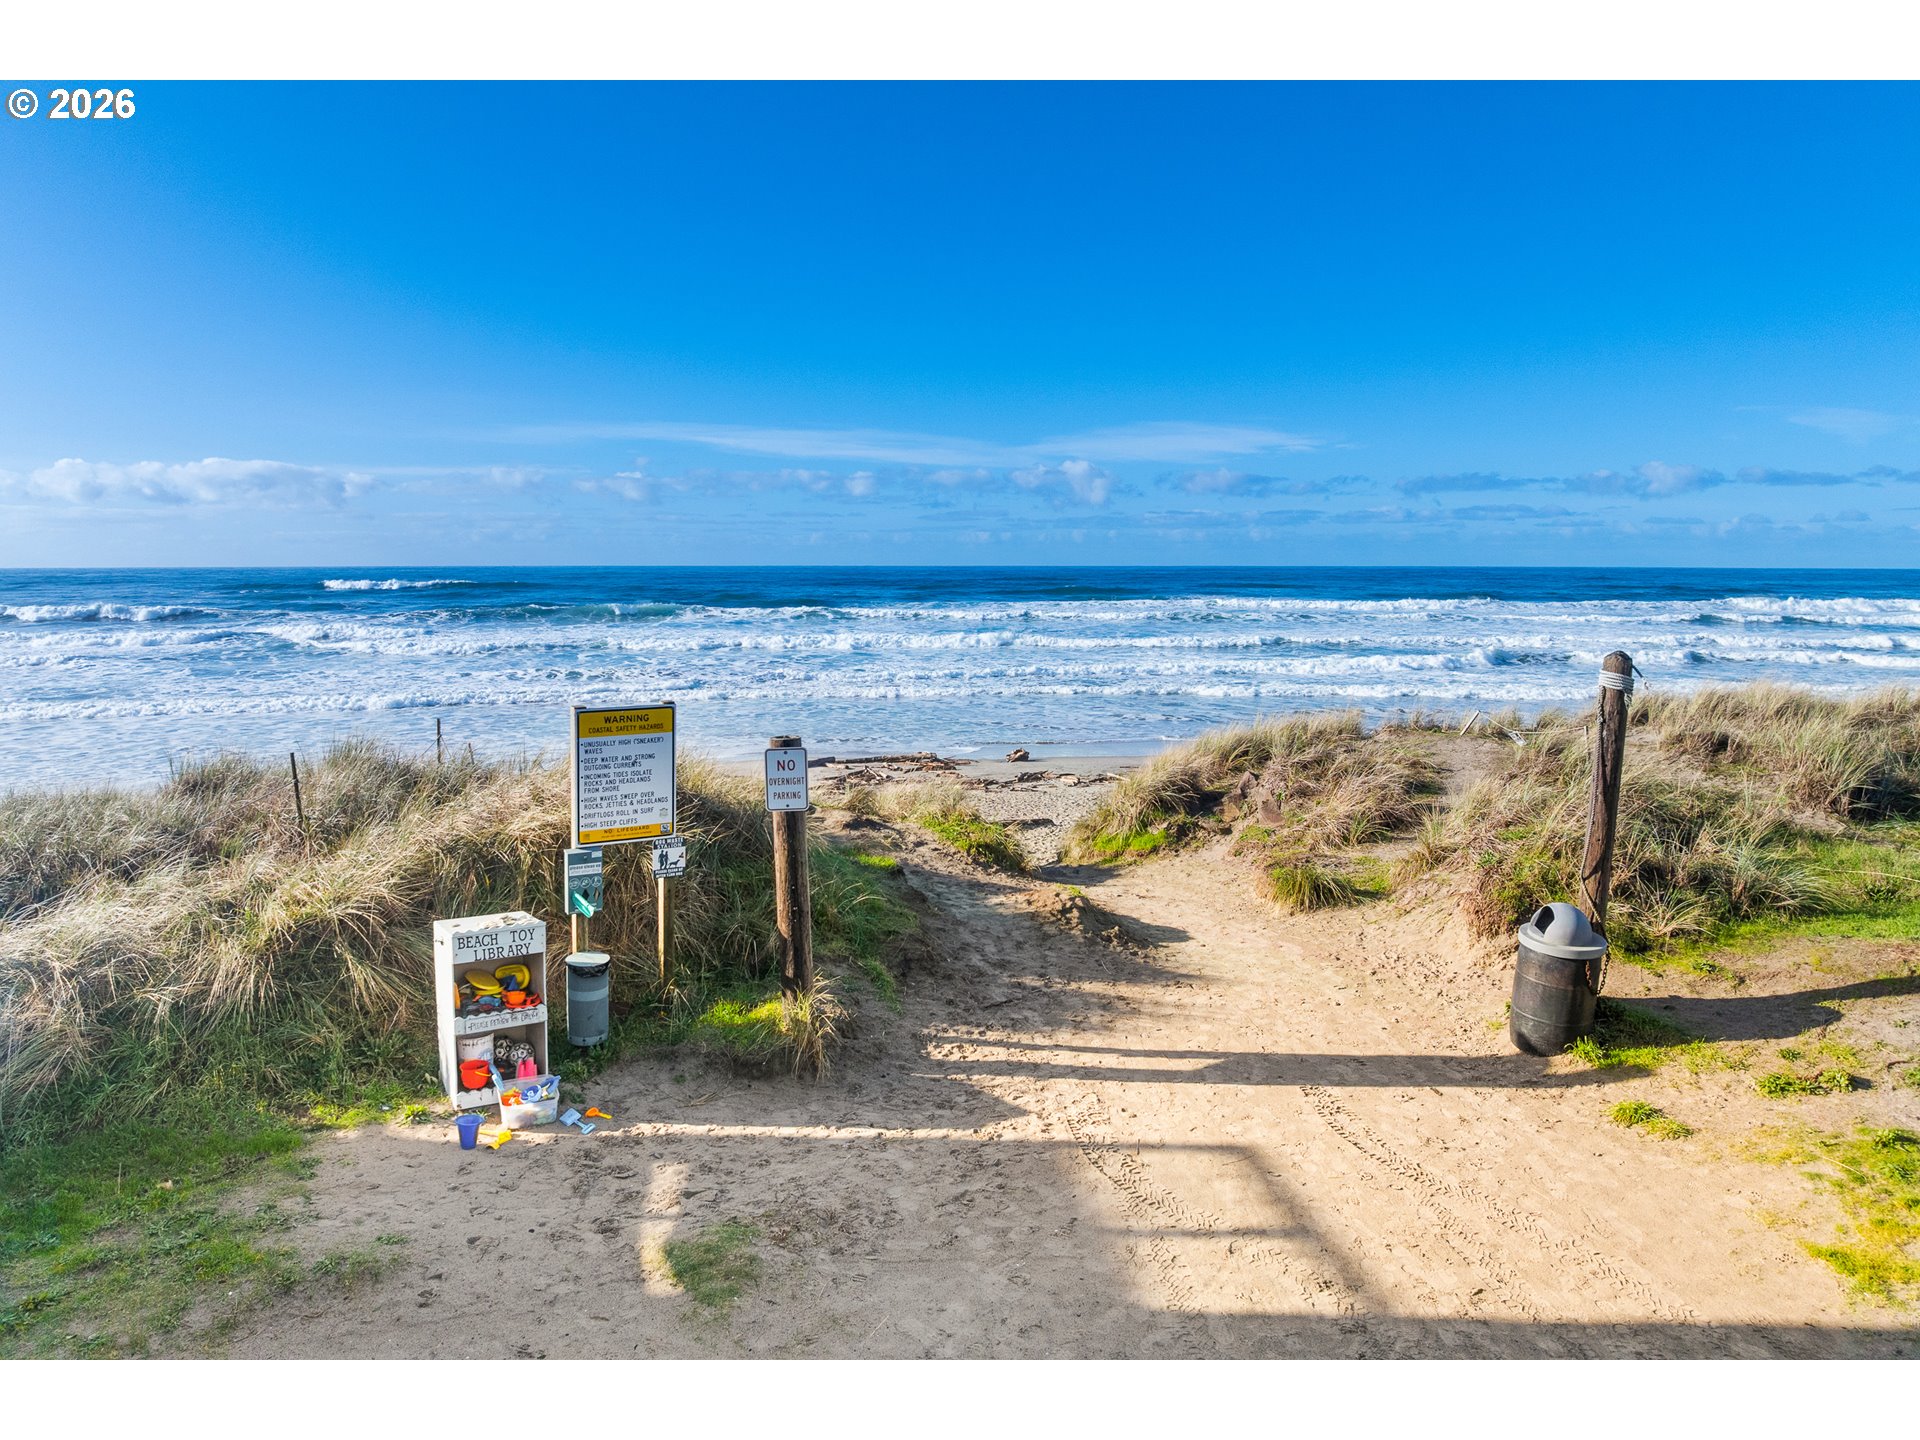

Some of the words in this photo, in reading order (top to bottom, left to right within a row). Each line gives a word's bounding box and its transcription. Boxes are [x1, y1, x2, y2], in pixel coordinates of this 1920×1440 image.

[604, 714, 649, 724] WARNING
[584, 740, 616, 748] UNUSUALLY
[601, 755, 618, 763] WATER
[584, 763, 611, 771] OUTGOING
[614, 761, 641, 769] CURRENTS
[777, 759, 796, 771] NO
[584, 772, 611, 780] INCOMING
[619, 776, 651, 784] HEADLANDS
[769, 777, 805, 786] OVERNIGHT
[773, 791, 801, 800] PARKING
[637, 796, 669, 804] HEADLANDS
[584, 811, 614, 819] DRIFTLOGS
[617, 825, 650, 833] LIFEGUARD
[457, 933, 498, 950] BEACH
[510, 928, 535, 943] TOY
[473, 943, 531, 961] LIBRARY
